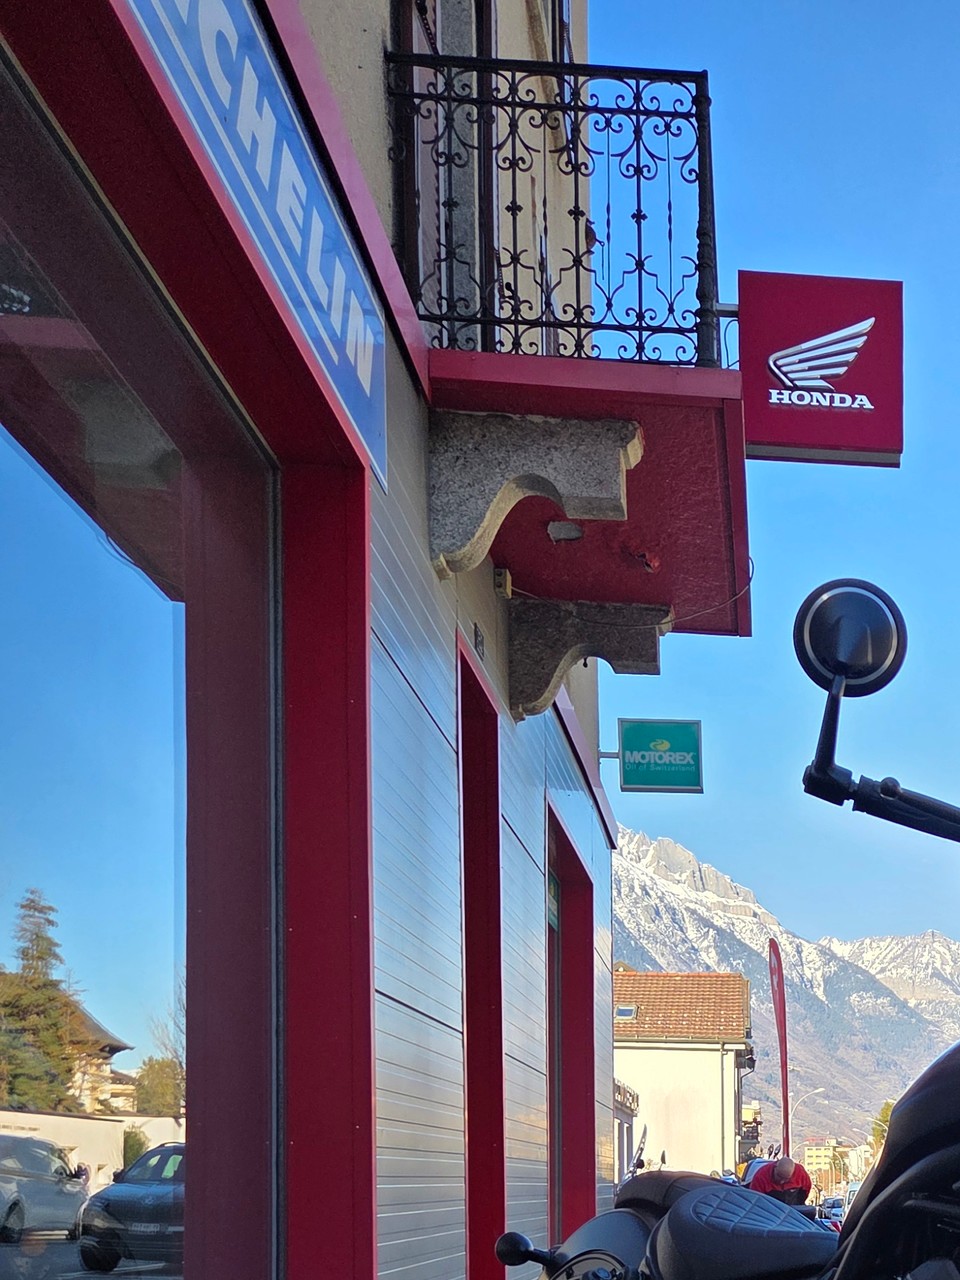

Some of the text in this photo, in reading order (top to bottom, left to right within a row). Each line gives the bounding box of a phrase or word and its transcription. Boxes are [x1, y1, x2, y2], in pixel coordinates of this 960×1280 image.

[175, 0, 375, 398] CHELIN
[768, 389, 875, 409] HONDA
[625, 751, 694, 764] MOTOREX
[650, 764, 696, 772] Switzerland
